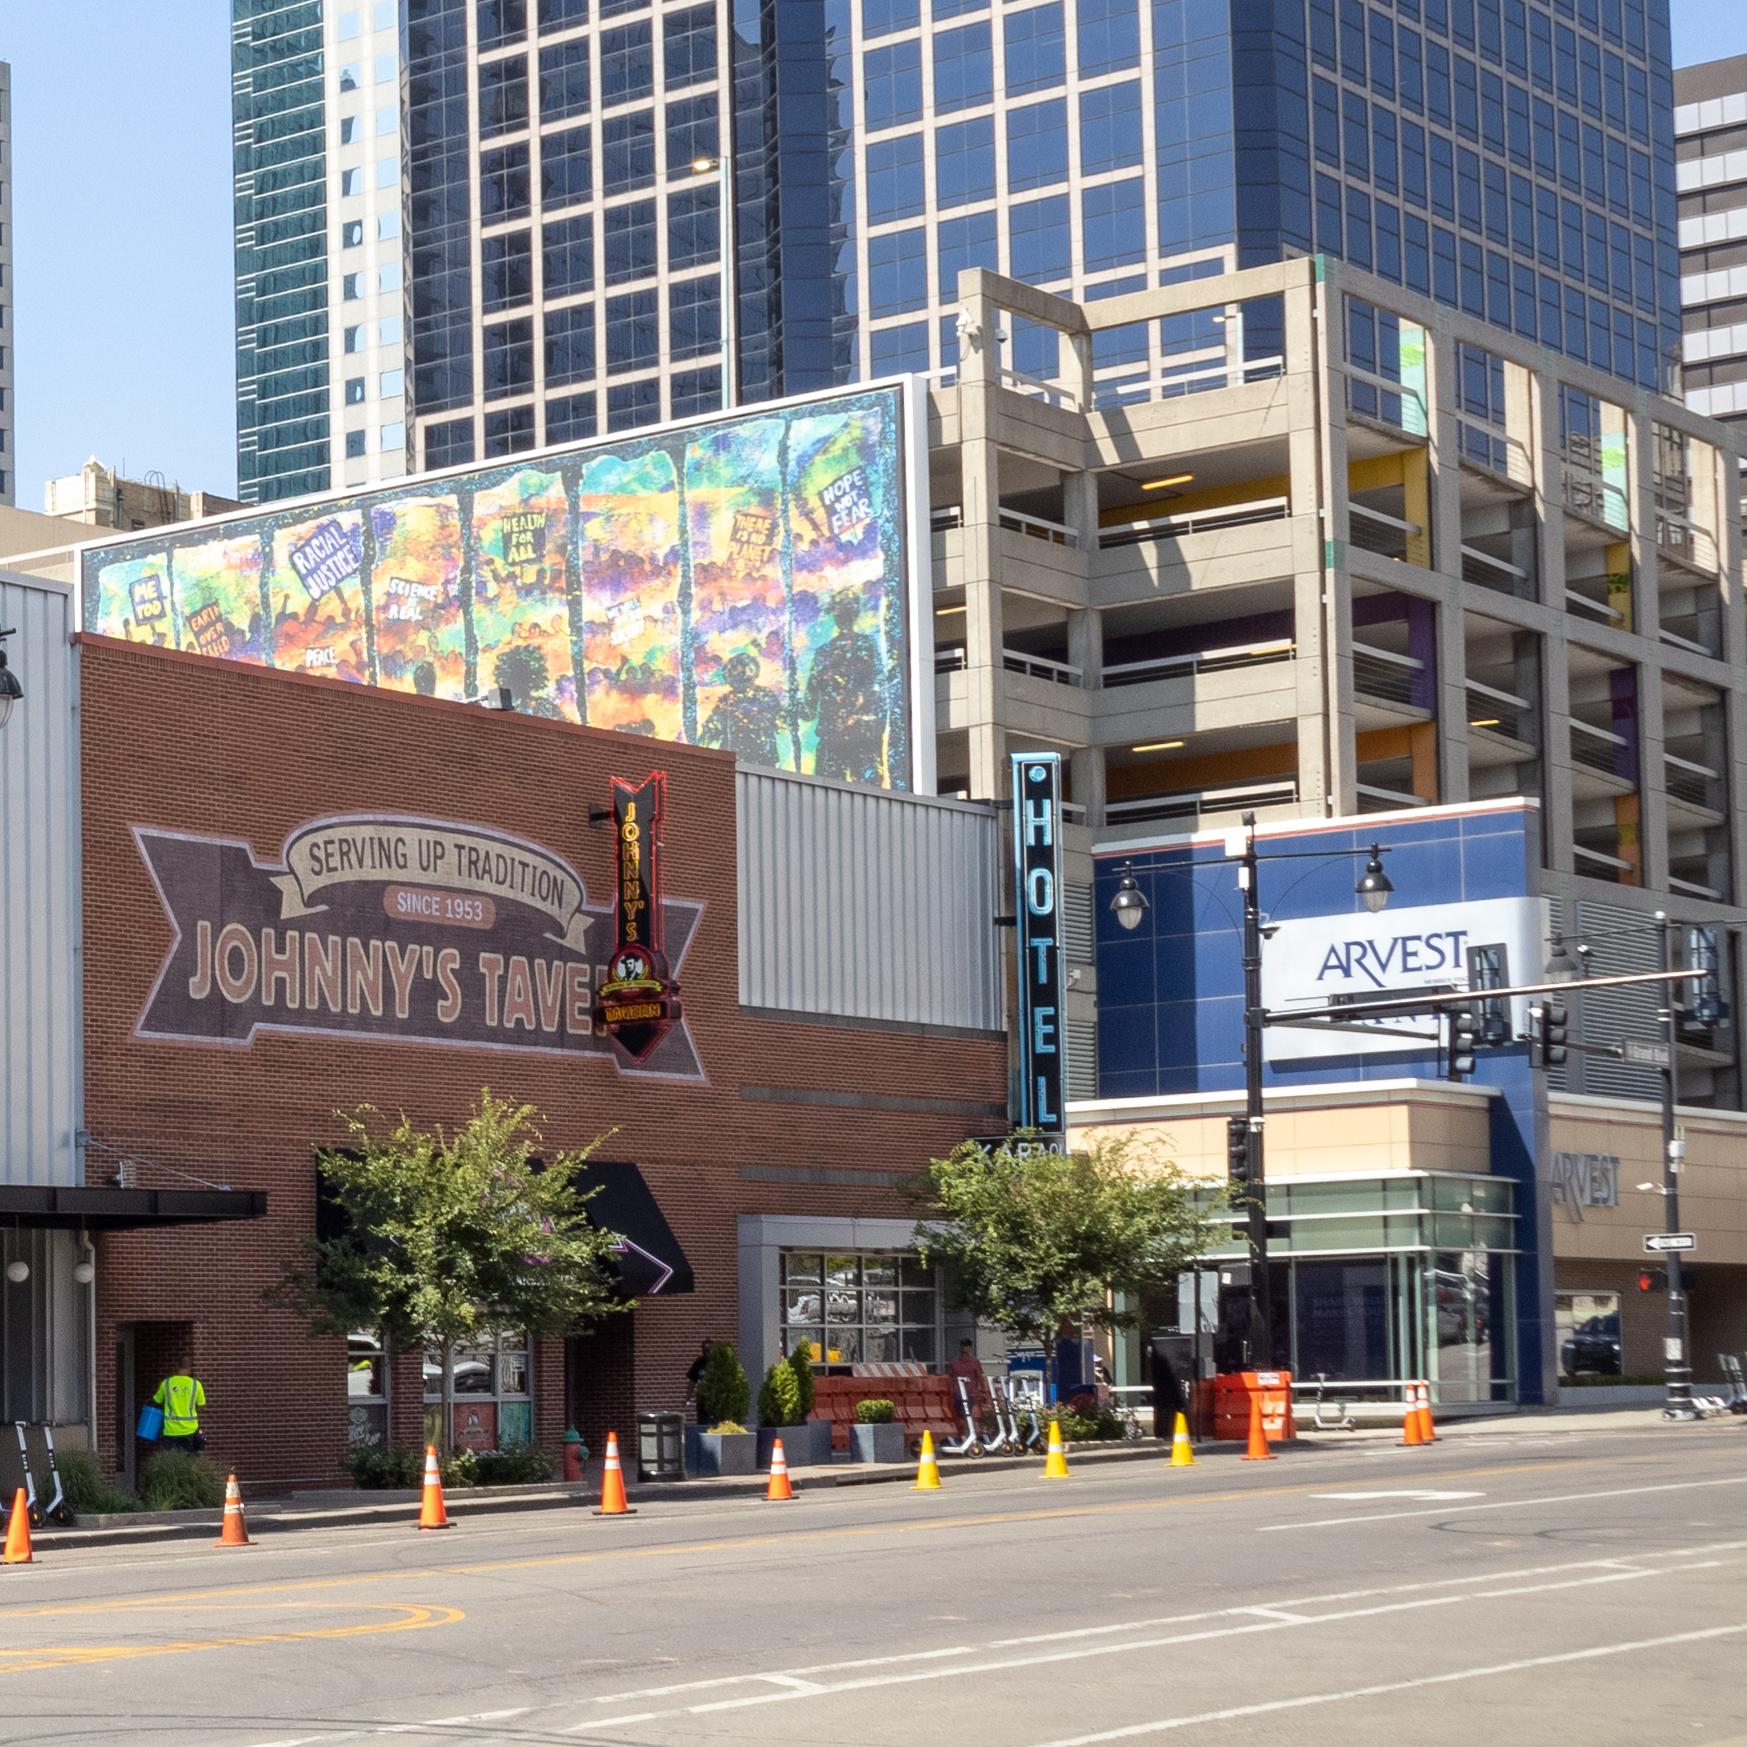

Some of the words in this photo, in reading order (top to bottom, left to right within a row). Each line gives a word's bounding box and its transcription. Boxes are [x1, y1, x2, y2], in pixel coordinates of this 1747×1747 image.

[823, 469, 864, 505] HOPE
[502, 513, 547, 534] HEALTH
[831, 498, 873, 535] FEAR
[292, 526, 348, 575] RACIAL
[508, 544, 537, 564] ALL
[511, 531, 534, 545] FOR
[307, 544, 359, 600] JUSTICE
[388, 578, 439, 601] SCIENCE
[133, 580, 158, 602] ME
[135, 600, 162, 620] TOO
[388, 604, 424, 622] REAL
[199, 621, 225, 645] OVER
[309, 836, 409, 876] SERVING
[418, 839, 447, 874] UP
[452, 843, 566, 911] TRADITION
[621, 801, 645, 942] JOHNNY'S
[396, 891, 441, 917] SINCE
[445, 896, 484, 922] 1953
[1025, 798, 1058, 1124] HOTEL
[1315, 929, 1468, 988] ARVEST
[188, 919, 463, 1024] JOHNNY'S
[478, 950, 608, 1038] TAVE
[1551, 1151, 1621, 1223] ARVEST
